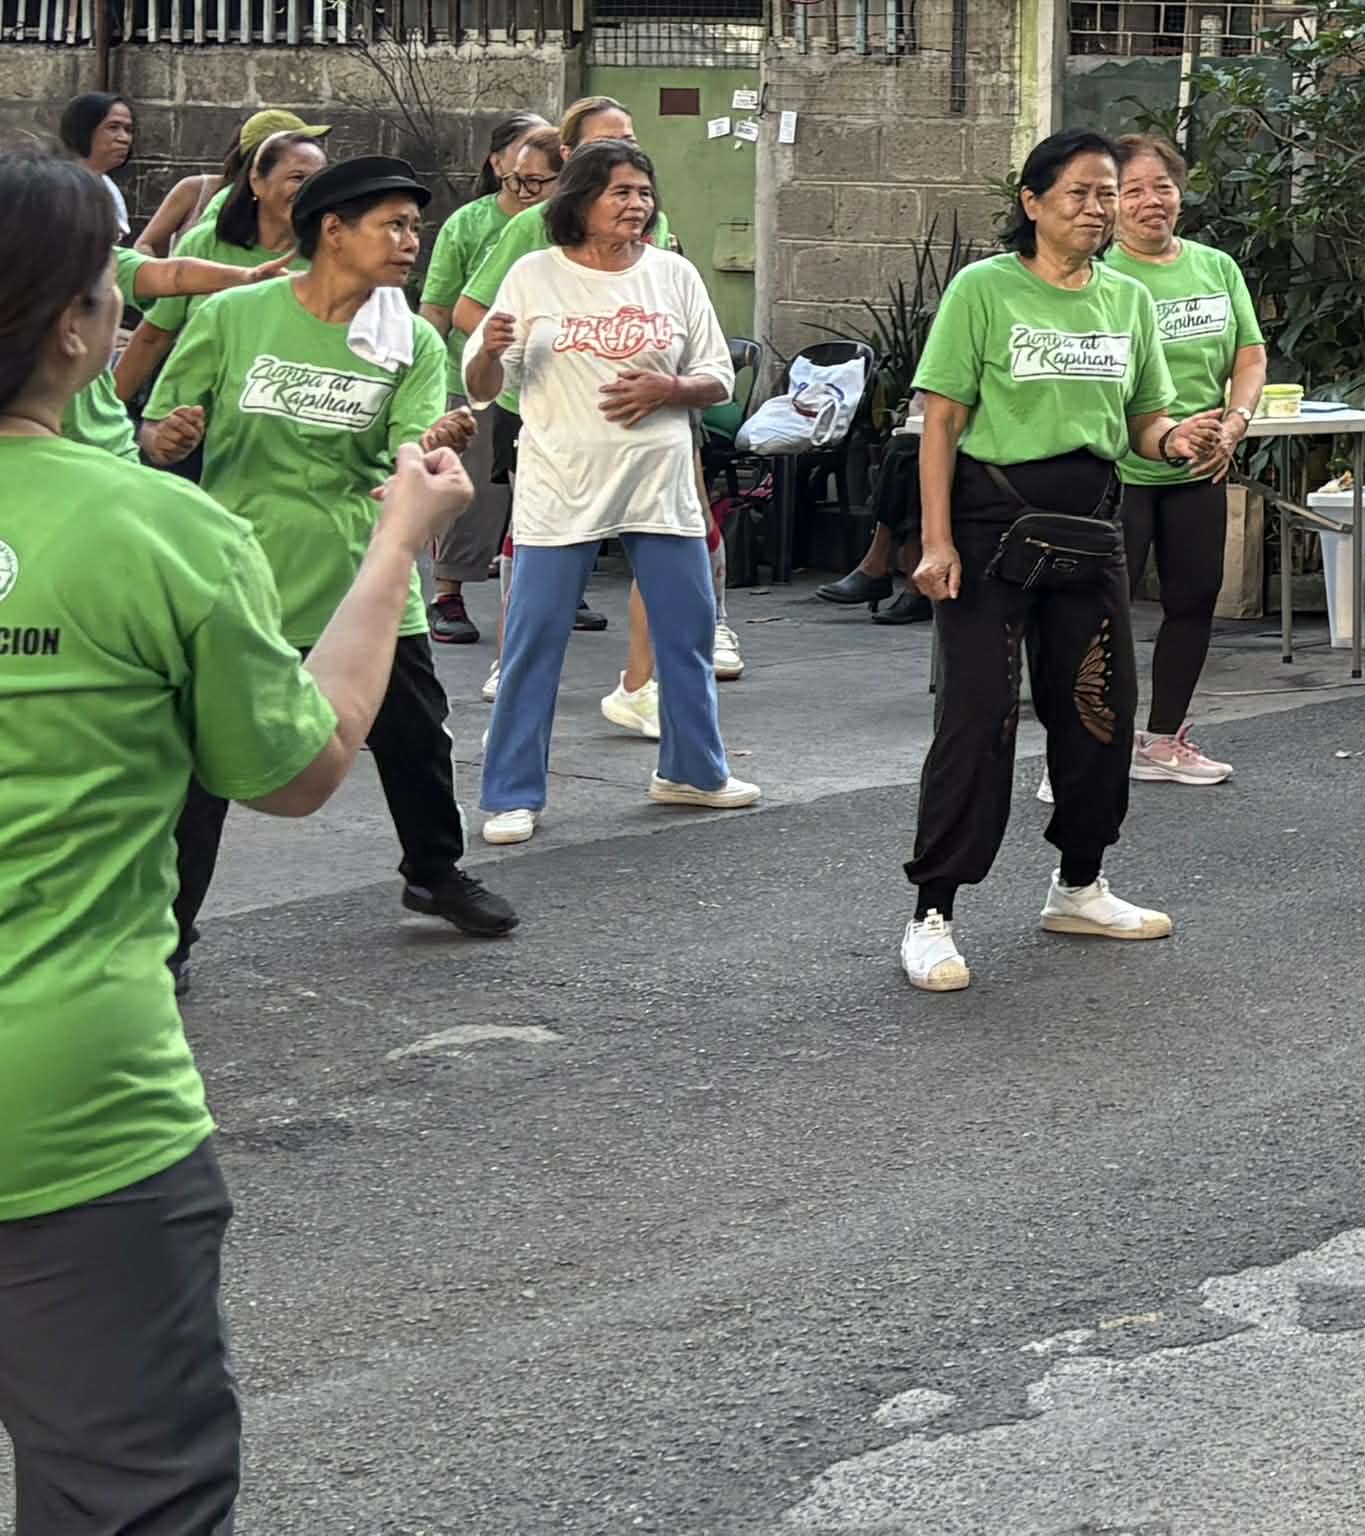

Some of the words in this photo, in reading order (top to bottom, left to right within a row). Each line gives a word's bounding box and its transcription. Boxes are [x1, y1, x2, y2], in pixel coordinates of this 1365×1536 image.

[1080, 334, 1099, 350] at
[1027, 346, 1126, 372] Kapihan
[328, 372, 355, 392] at
[261, 378, 377, 416] Kapihan
[0, 627, 60, 656] CION
